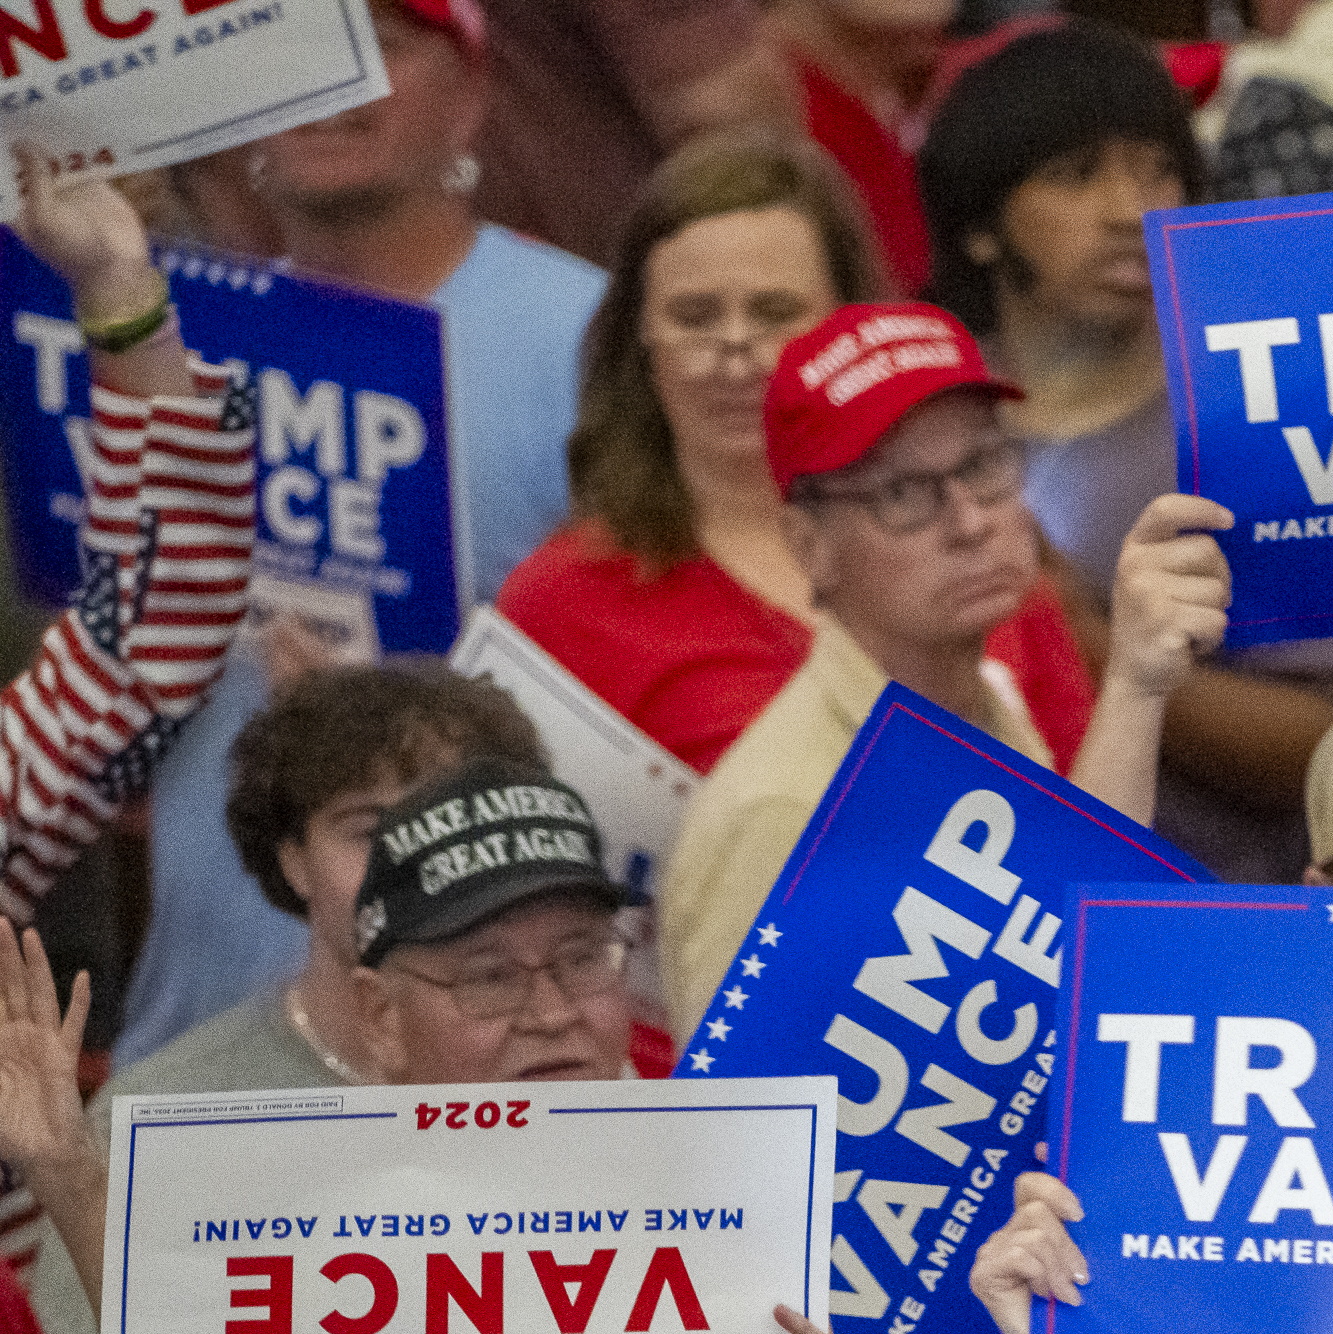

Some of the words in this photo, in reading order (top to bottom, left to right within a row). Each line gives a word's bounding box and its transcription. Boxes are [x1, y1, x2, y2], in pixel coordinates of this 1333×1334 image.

[13, 310, 428, 480] TMP
[383, 798, 467, 865] MAKE
[419, 832, 510, 896] GREAT
[823, 788, 1022, 1204] UMP
[414, 1100, 531, 1131] 2024
[828, 894, 1063, 1321] VANCE
[193, 1215, 315, 1244] AGAIN!
[333, 1211, 452, 1240] GREAT
[466, 1209, 628, 1236] AMERICA
[644, 1208, 744, 1232] MAKE
[921, 1147, 1009, 1293] AMERICA
[1122, 1234, 1225, 1263] MAKE
